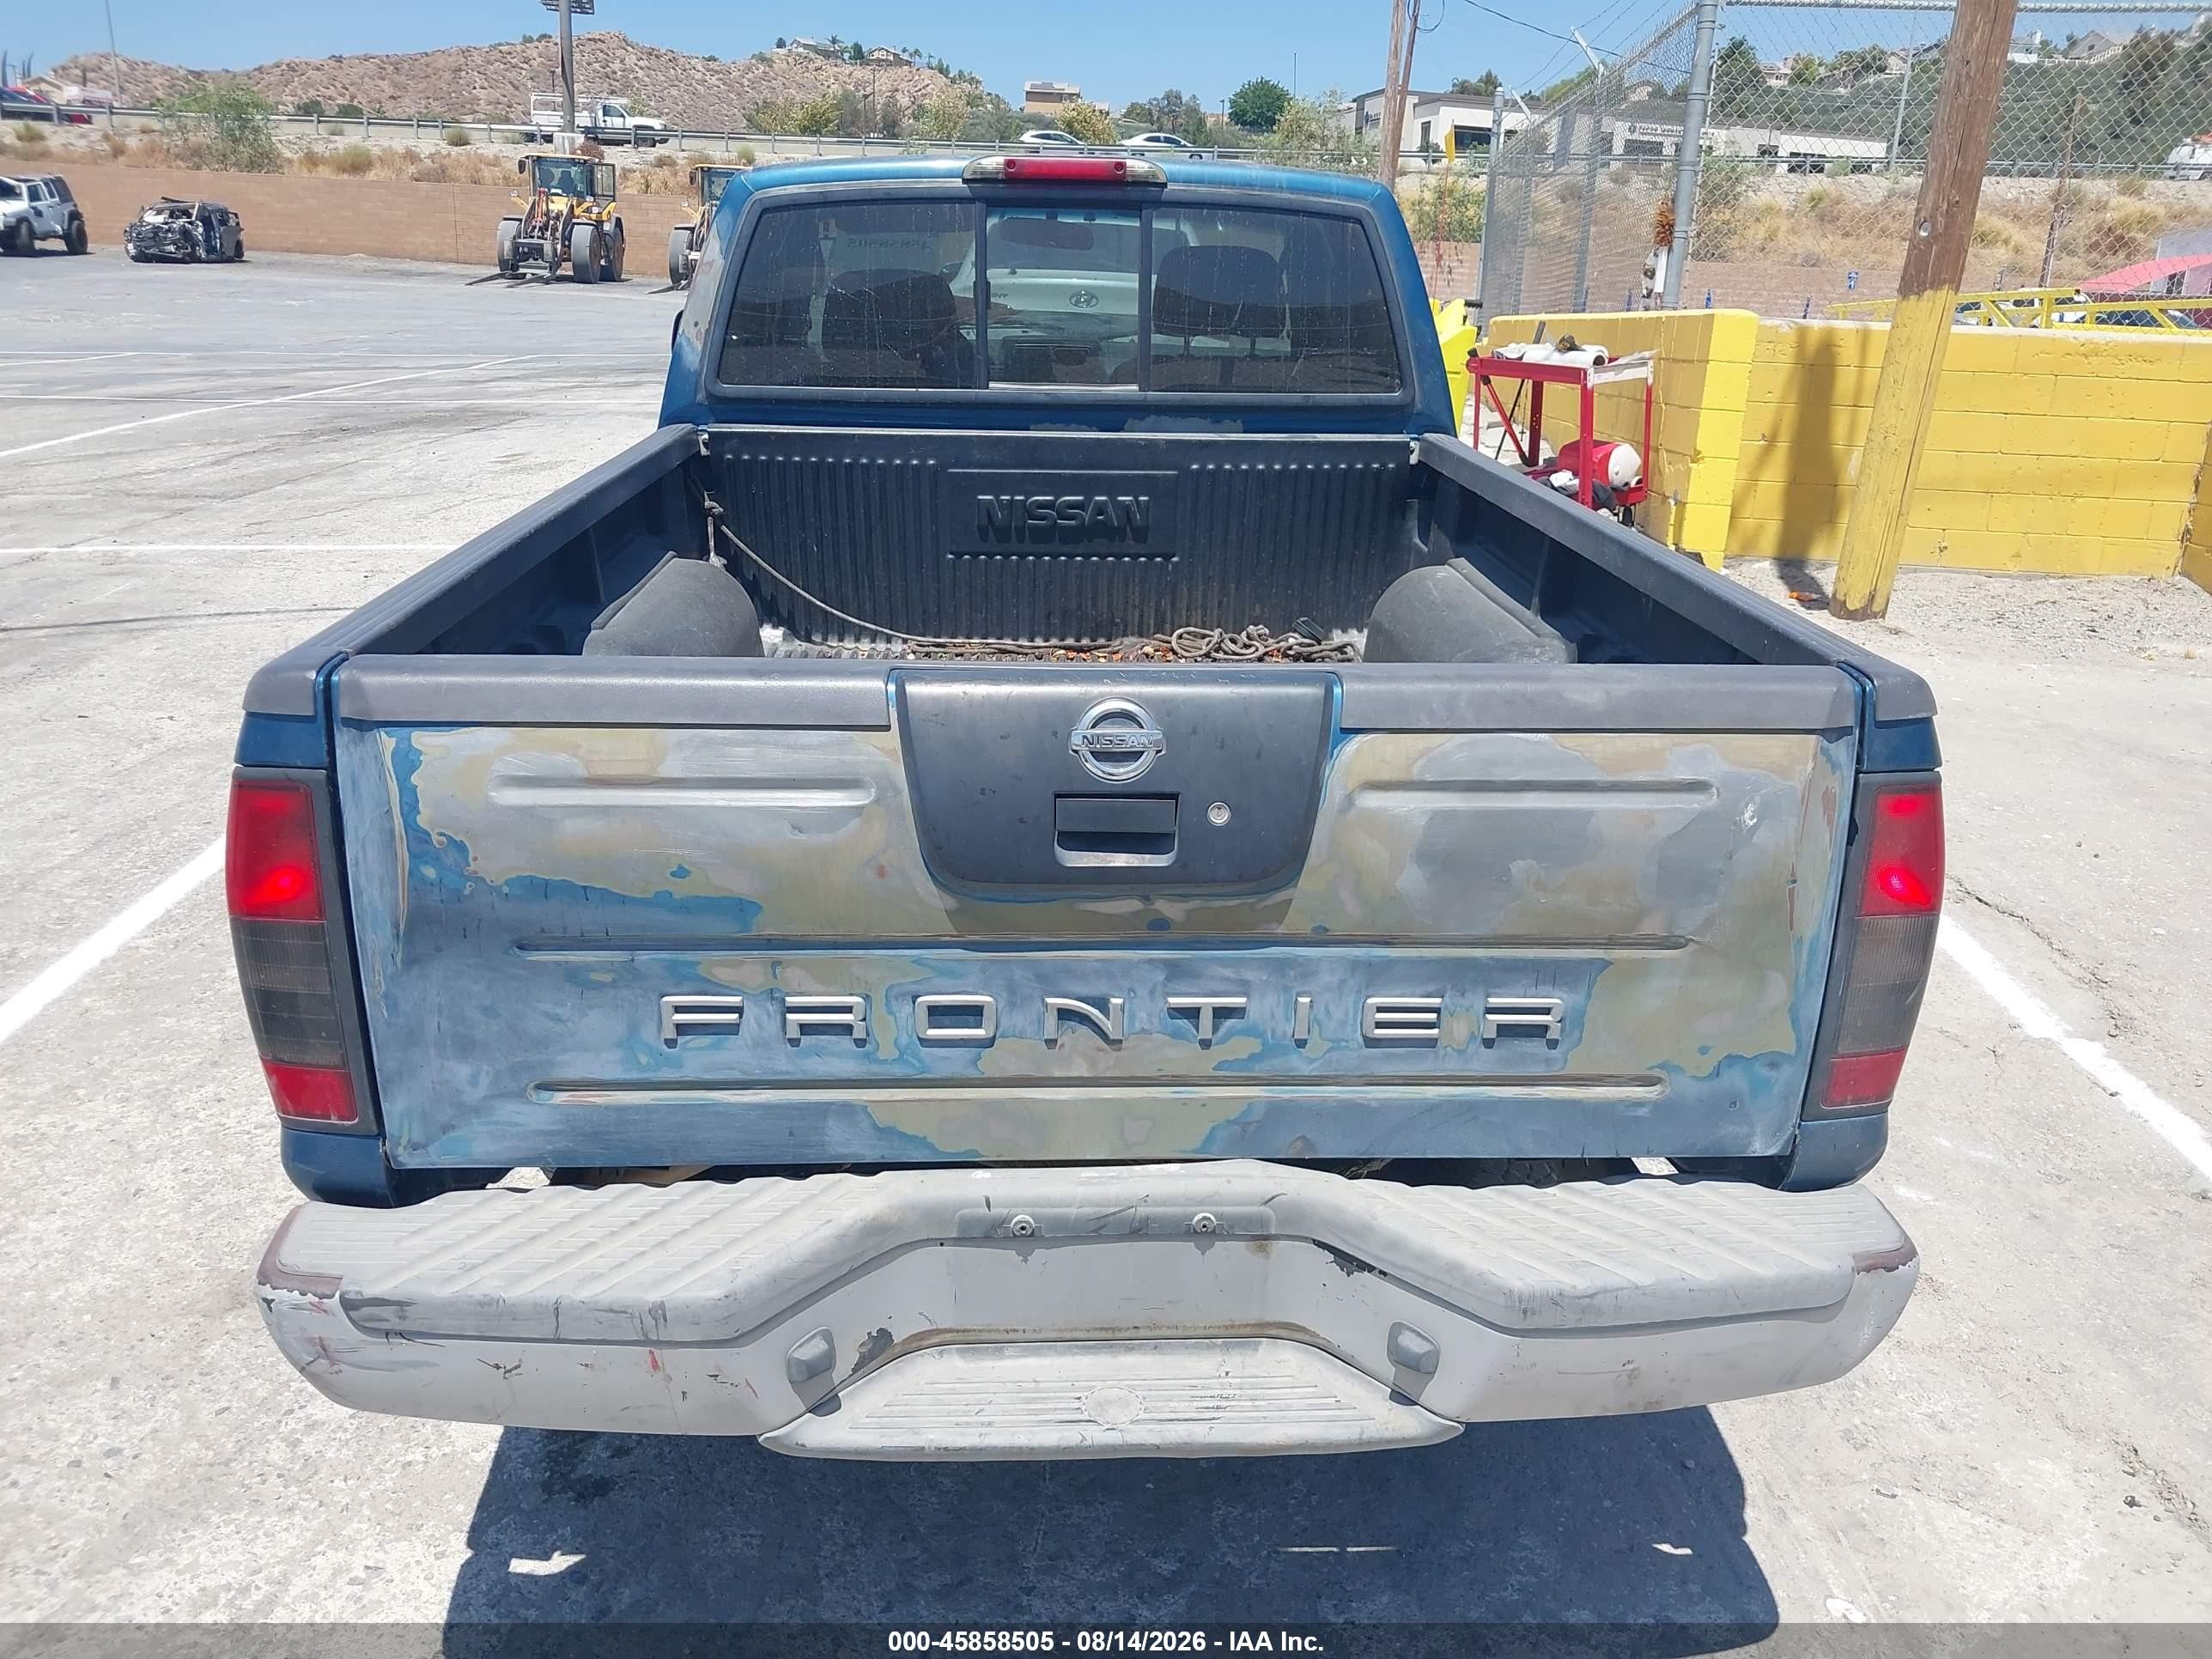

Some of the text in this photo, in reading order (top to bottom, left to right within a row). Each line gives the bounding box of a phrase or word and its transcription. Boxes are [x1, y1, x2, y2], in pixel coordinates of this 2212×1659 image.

[976, 495, 1150, 544] NISSAN
[1081, 734, 1154, 748] NISSAN
[659, 994, 1565, 1049] FRONTIER
